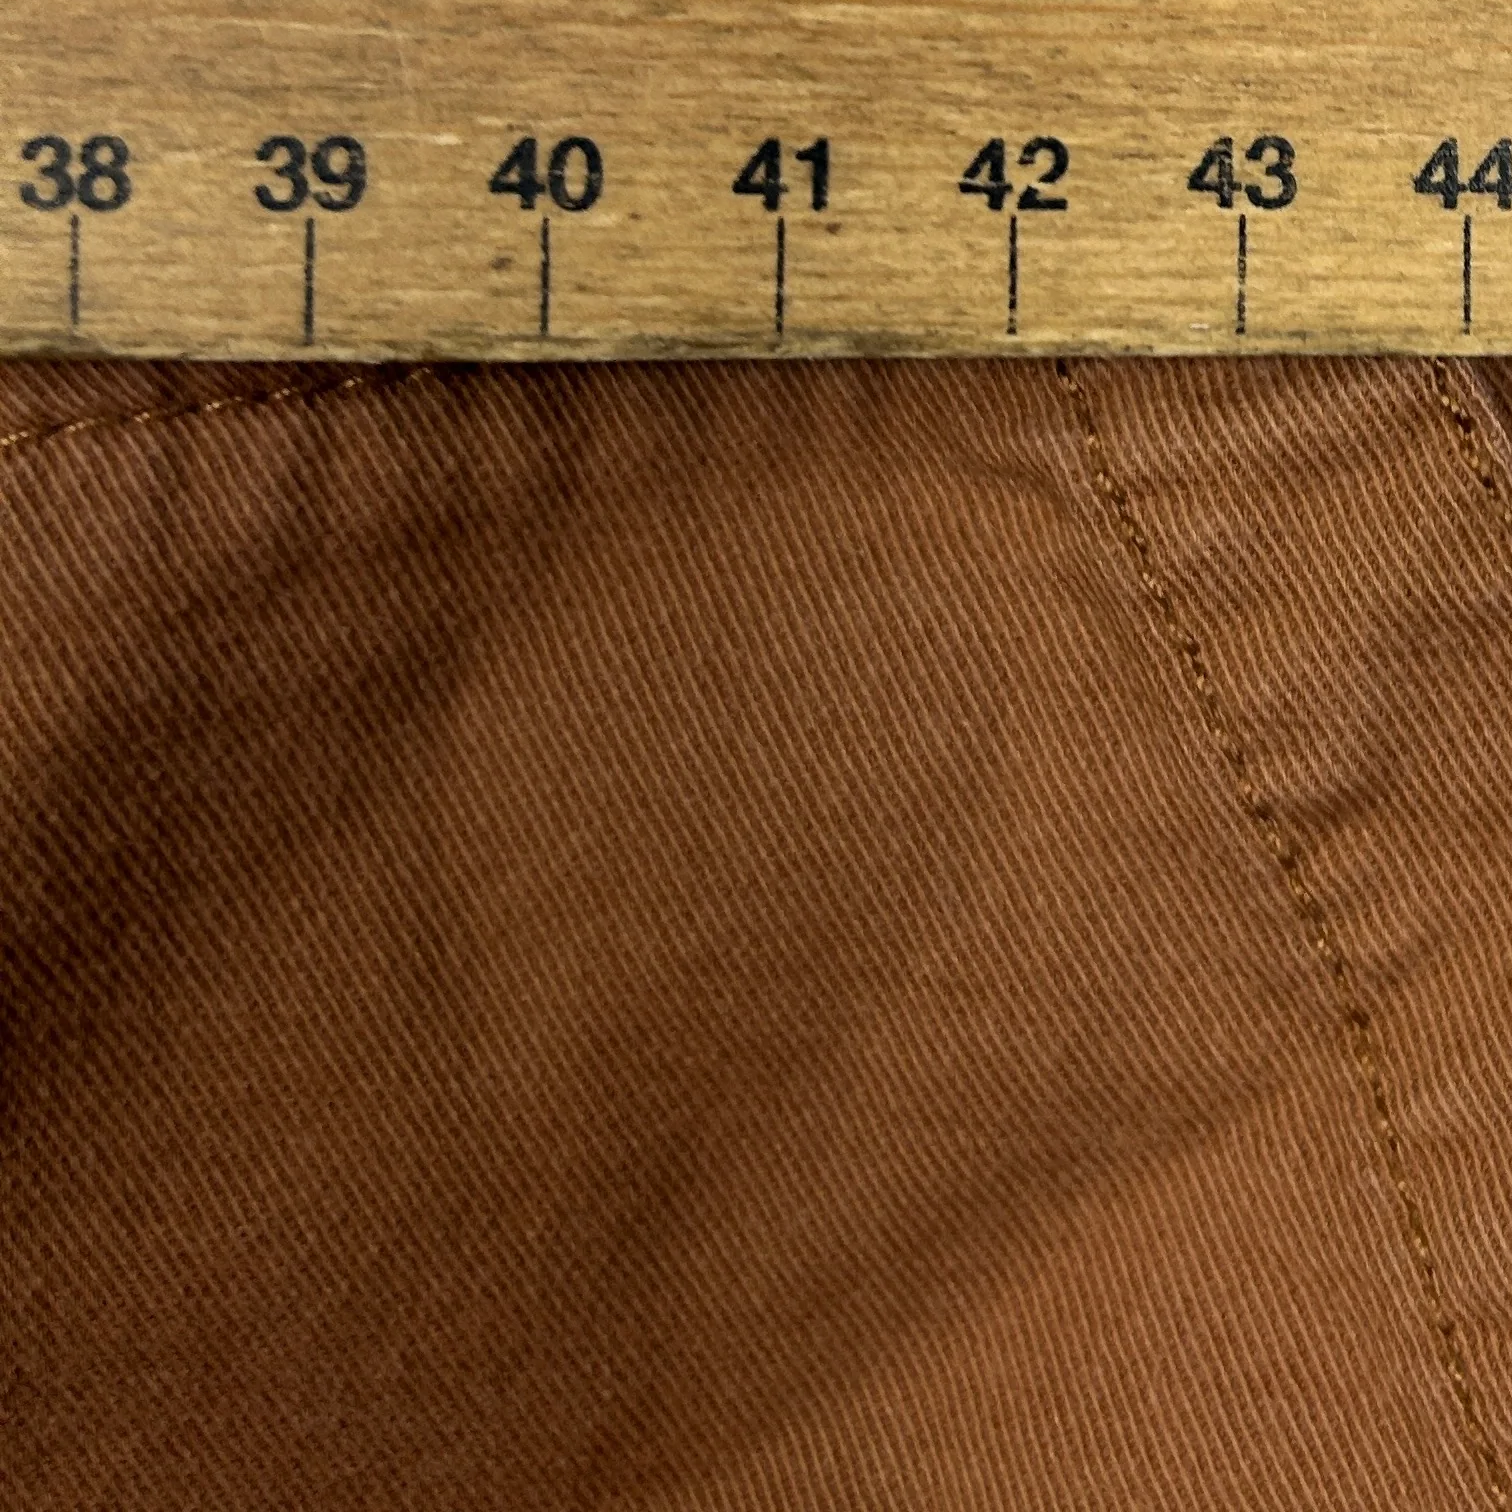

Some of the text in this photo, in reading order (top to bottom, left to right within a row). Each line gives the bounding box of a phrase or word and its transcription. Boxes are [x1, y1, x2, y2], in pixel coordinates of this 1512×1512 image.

[20, 134, 129, 211] 38
[255, 134, 367, 211] 39
[488, 135, 604, 211] 40
[732, 136, 832, 211] 41
[958, 136, 1070, 211] 42
[1187, 137, 1298, 211] 43
